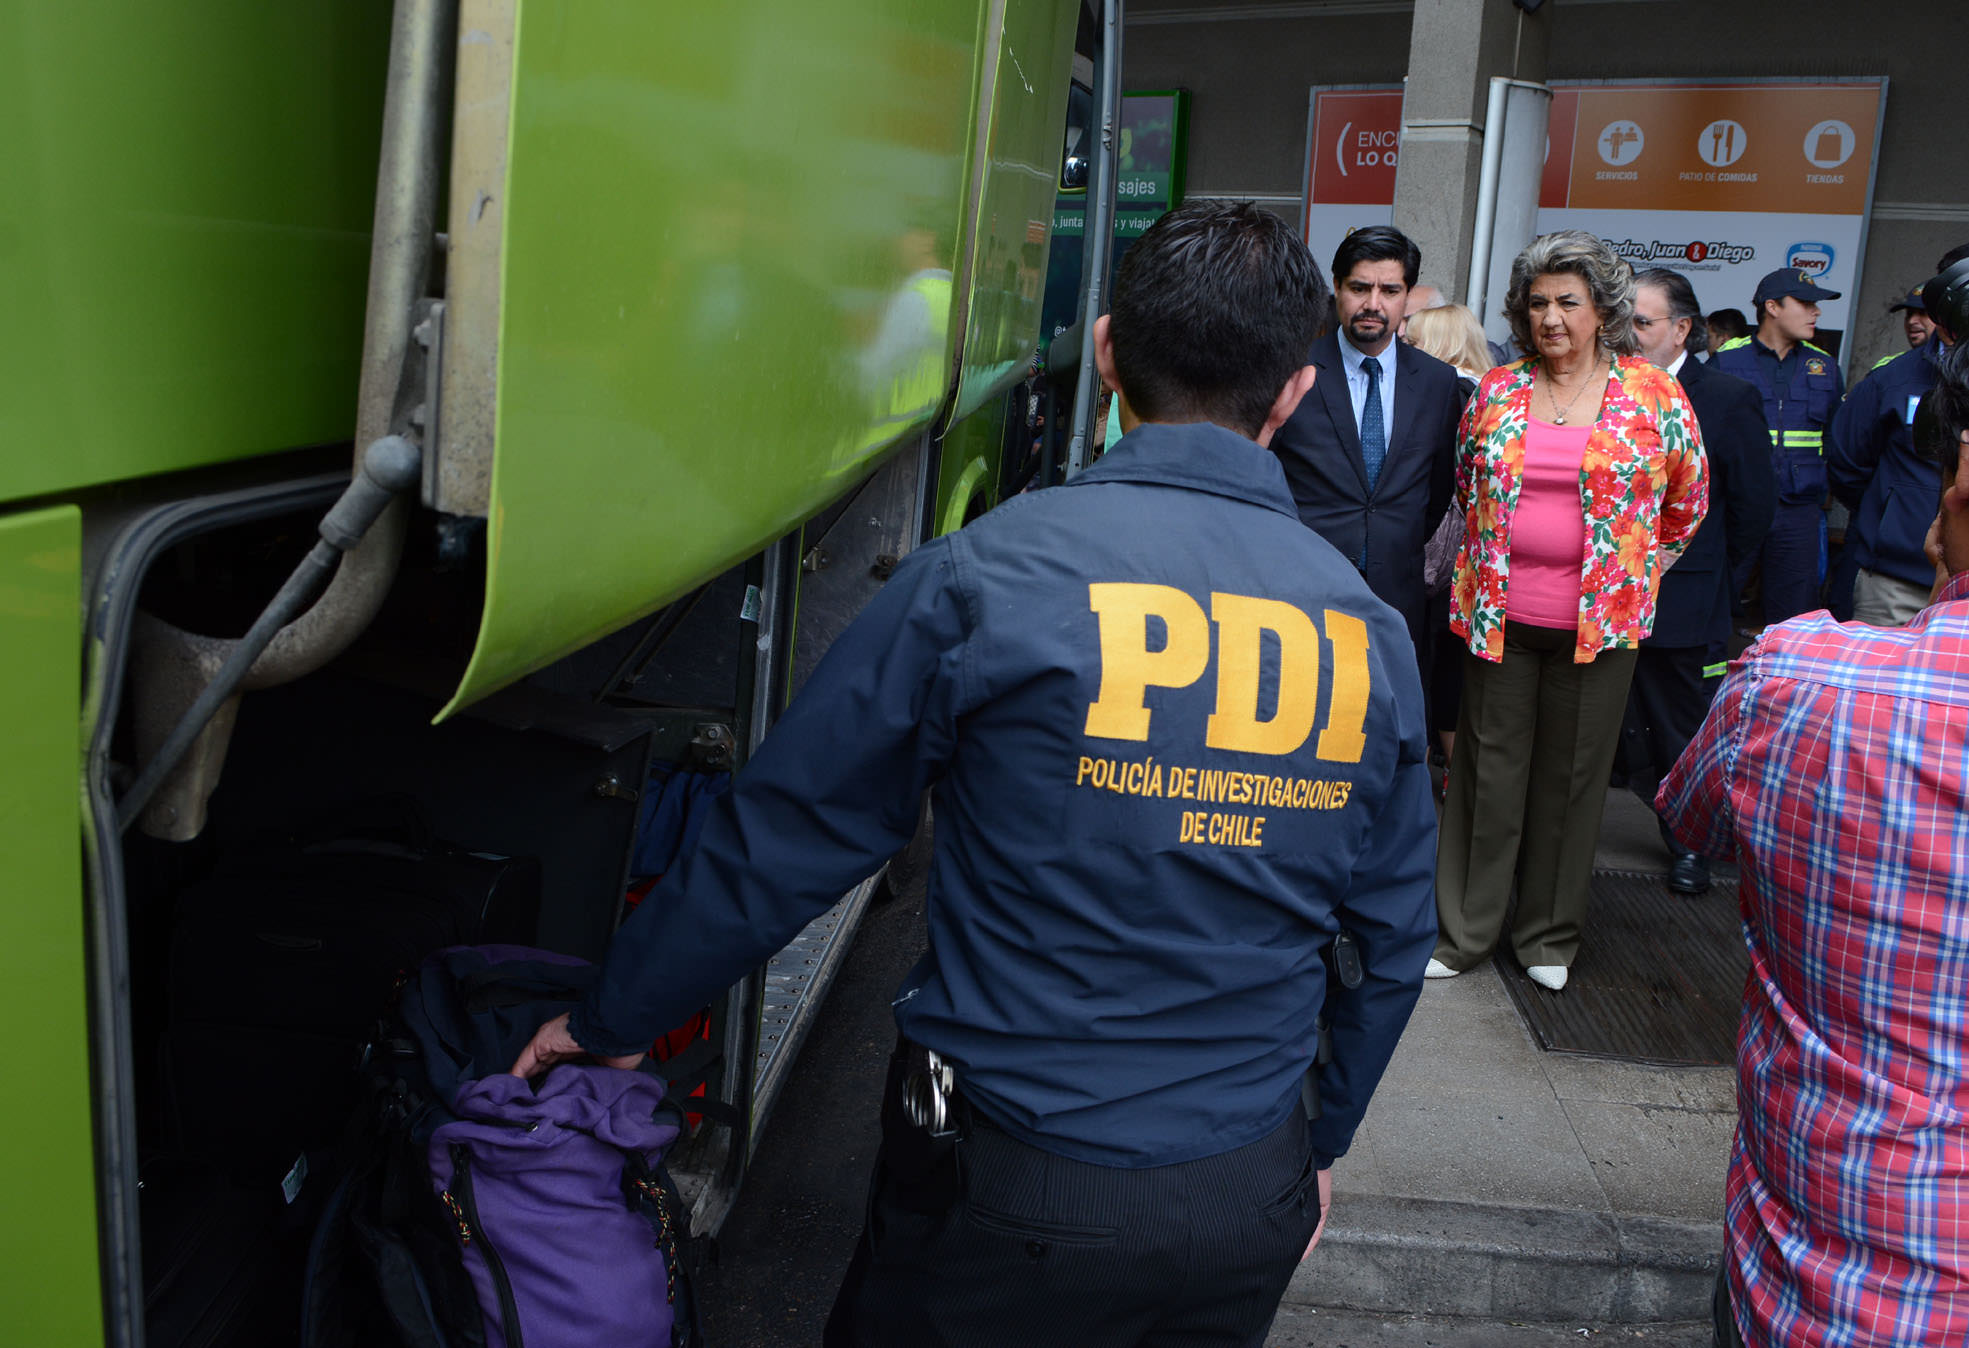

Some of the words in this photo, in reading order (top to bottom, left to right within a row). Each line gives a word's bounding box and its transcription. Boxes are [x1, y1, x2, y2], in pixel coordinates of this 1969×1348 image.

[1356, 151, 1379, 166] LO
[1595, 171, 1639, 181] SERVICIOS
[1679, 171, 1703, 181] PATIO
[1704, 172, 1716, 182] DE
[1717, 172, 1759, 182] COMIDAS
[1806, 174, 1845, 184] TIENDAS
[1118, 177, 1156, 197] sajes
[1647, 240, 1687, 261] Juan
[1706, 241, 1755, 264] Diego
[1792, 256, 1826, 271] Savory
[1084, 582, 1371, 763] PDI
[1076, 756, 1163, 798] POLICÍA
[1167, 767, 1197, 799] DE
[1197, 769, 1353, 810] INVESTIGACIONES
[1179, 811, 1208, 843] DE
[1208, 813, 1267, 847] CHILE
